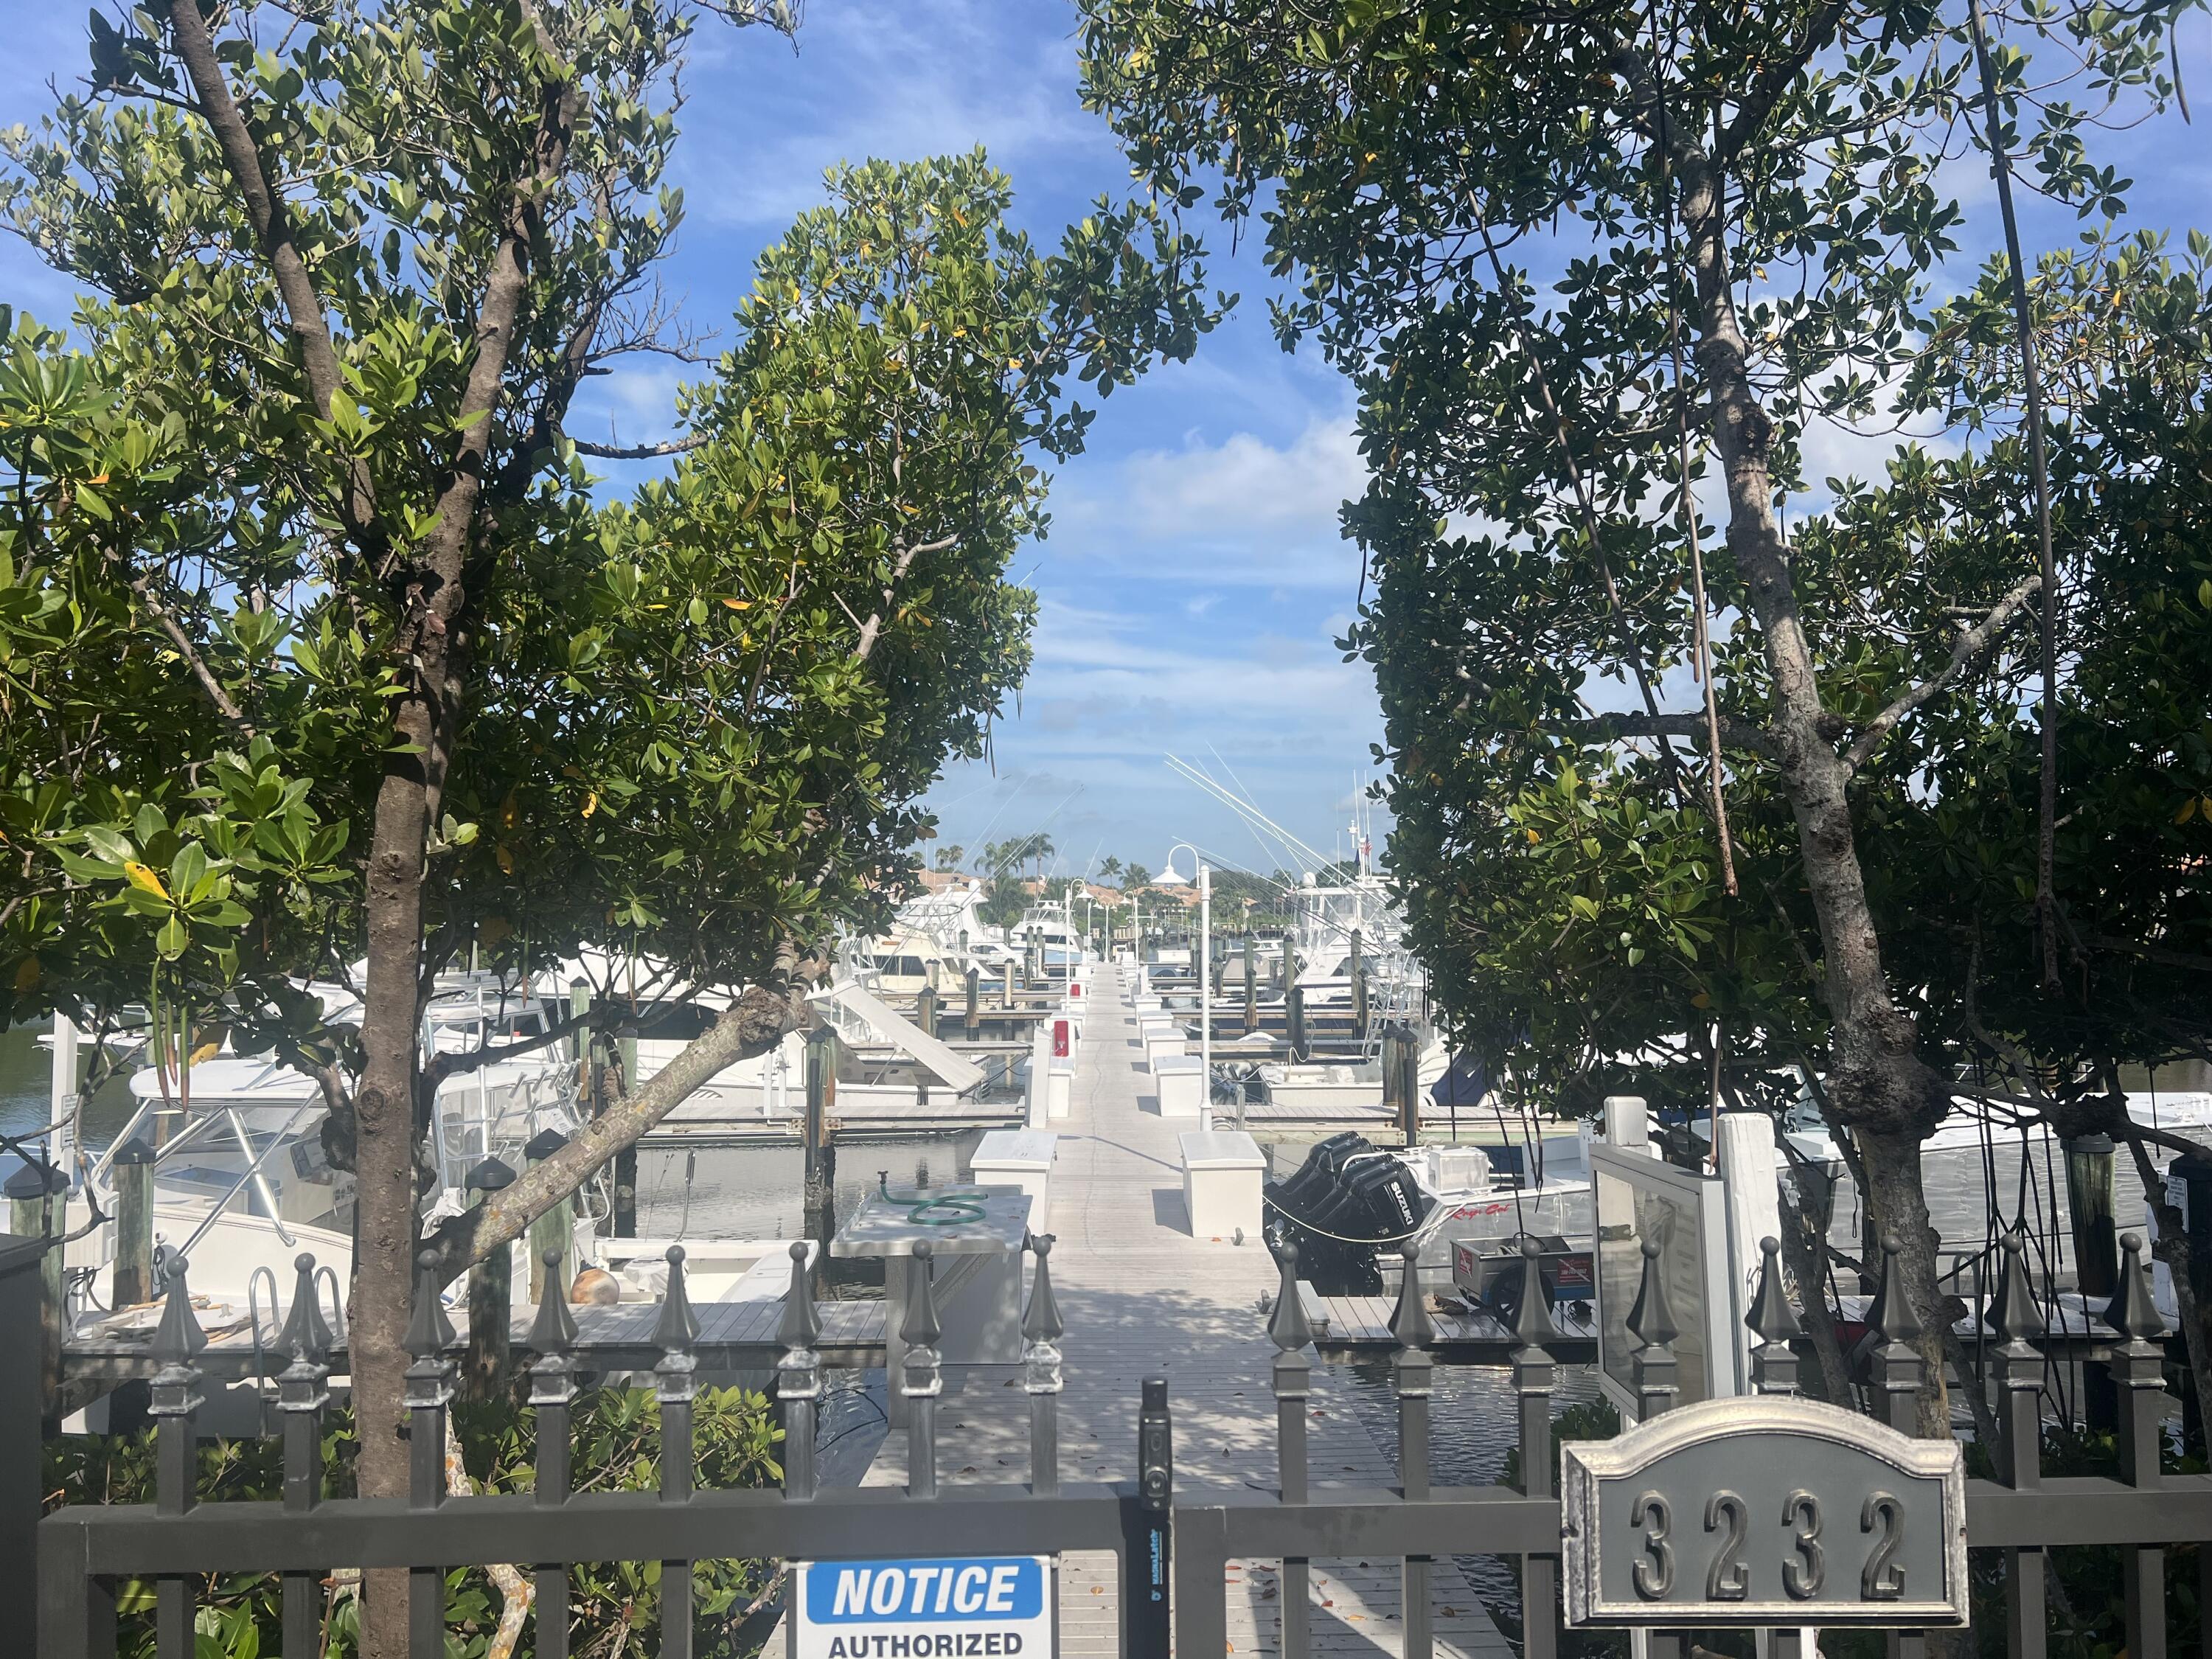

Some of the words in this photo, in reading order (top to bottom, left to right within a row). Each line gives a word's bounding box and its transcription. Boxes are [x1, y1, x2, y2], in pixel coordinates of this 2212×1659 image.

[1391, 1181, 1414, 1225] SUZUKI
[1631, 1489, 1905, 1599] 3232
[832, 1565, 1019, 1615] NOTICE
[828, 1632, 1023, 1658] AUTHORIZED
